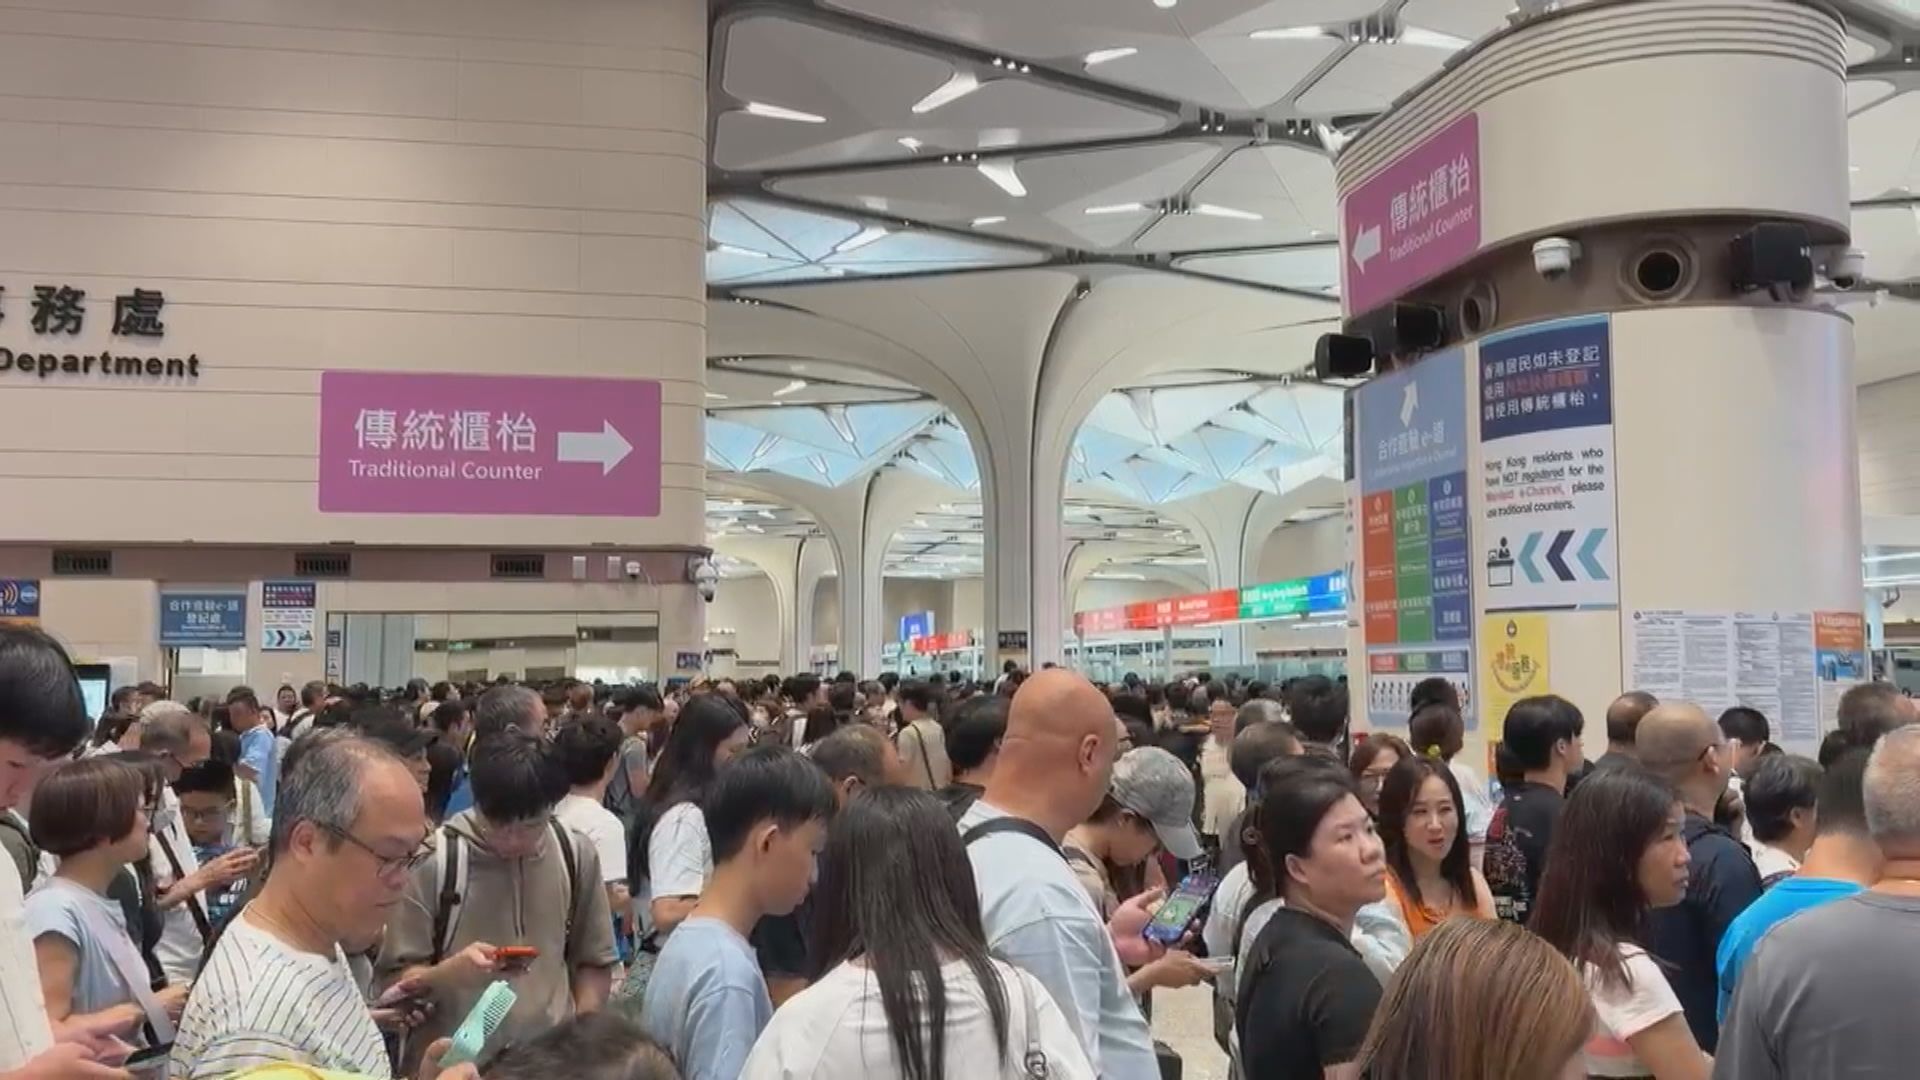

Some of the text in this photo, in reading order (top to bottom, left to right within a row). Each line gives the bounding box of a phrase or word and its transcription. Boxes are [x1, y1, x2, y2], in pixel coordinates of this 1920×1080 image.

[1390, 153, 1470, 235] 傳統櫃枱
[1389, 204, 1473, 262] Traditional Counter
[0, 285, 164, 336] 務處
[0, 347, 199, 378] Department
[355, 408, 536, 452] 傳統櫃枱
[348, 459, 543, 480] Traditional Counter
[1506, 456, 1526, 468] Kong
[1532, 451, 1574, 463] residents
[1581, 448, 1604, 459] who
[1502, 472, 1519, 482] NOT
[1522, 467, 1565, 483] registered
[1569, 466, 1584, 476] for
[1587, 464, 1604, 475] the
[1572, 481, 1605, 495] please
[1534, 500, 1575, 512] counters.
